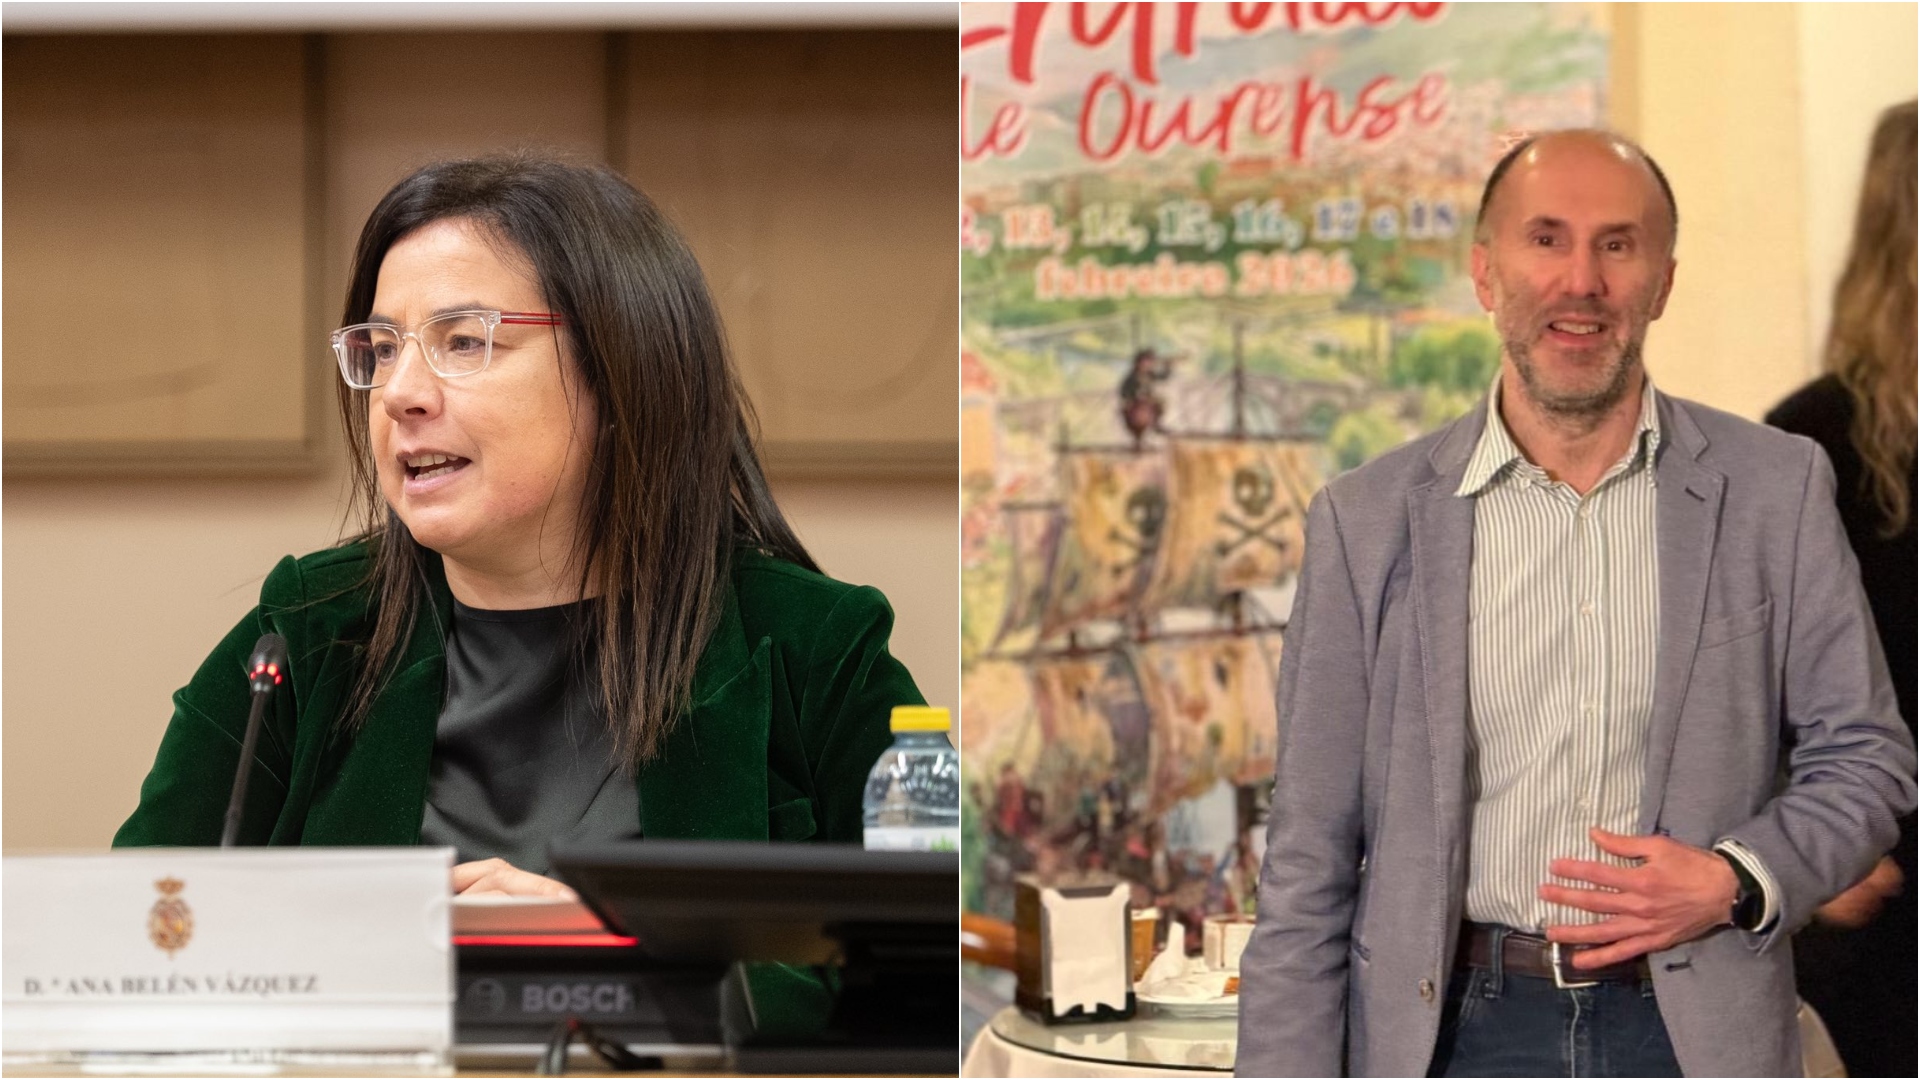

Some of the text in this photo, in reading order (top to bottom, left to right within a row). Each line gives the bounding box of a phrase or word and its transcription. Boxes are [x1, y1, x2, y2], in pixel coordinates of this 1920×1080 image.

[1079, 71, 1446, 157] Ourense
[1003, 204, 1070, 254] 13,
[1232, 200, 1303, 249] 16,
[1312, 199, 1362, 240] 17
[1407, 200, 1456, 237] 18
[1235, 250, 1357, 297] 2026
[65, 976, 114, 994] ANA
[121, 971, 198, 994] BELÉN
[205, 971, 320, 997] VÁZQUEZ
